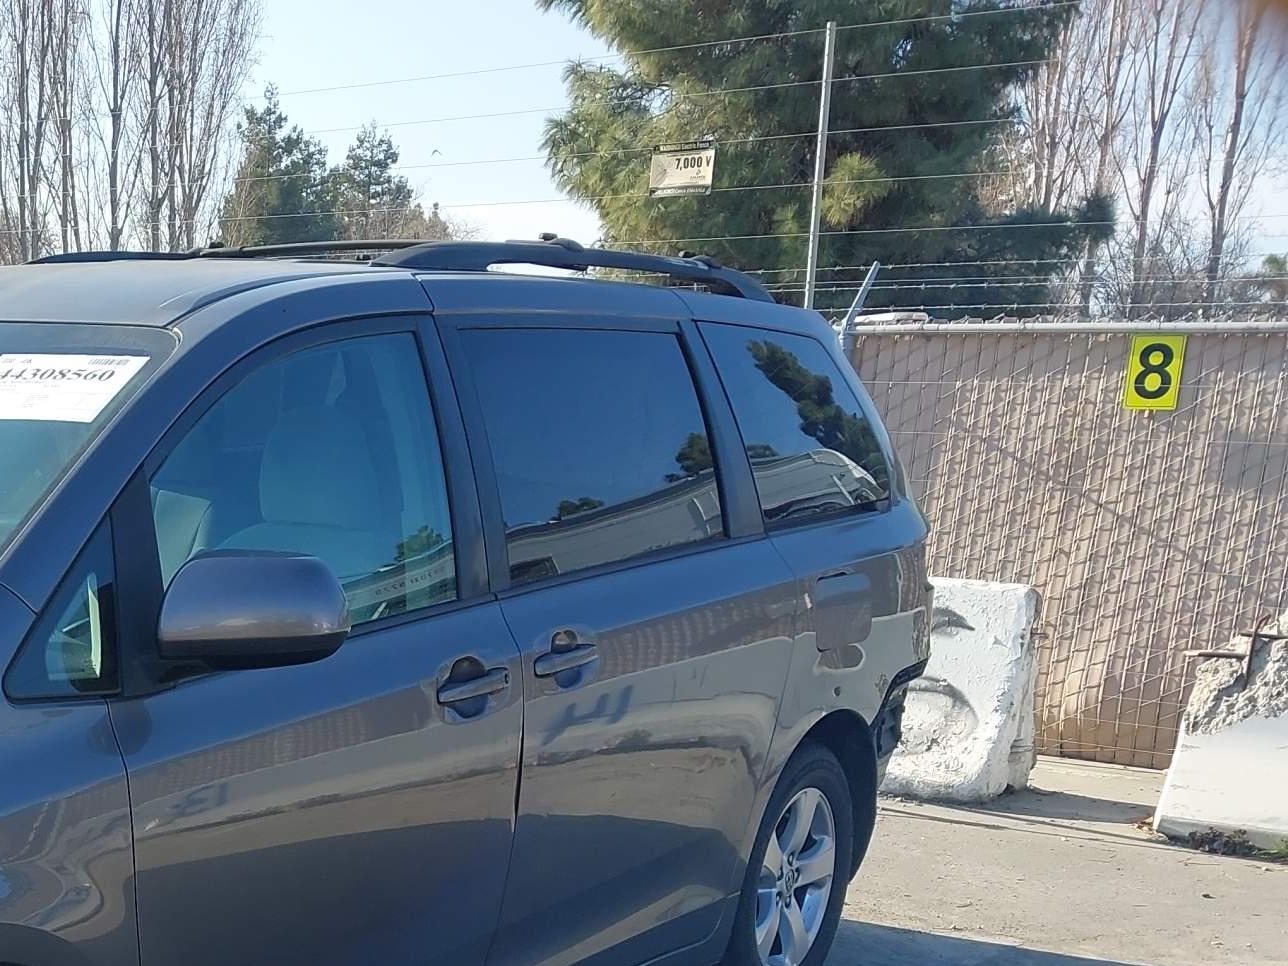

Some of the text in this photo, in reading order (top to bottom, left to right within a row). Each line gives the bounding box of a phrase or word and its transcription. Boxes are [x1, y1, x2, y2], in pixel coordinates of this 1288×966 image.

[675, 155, 712, 171] 7,000 V
[1134, 343, 1174, 399] 8
